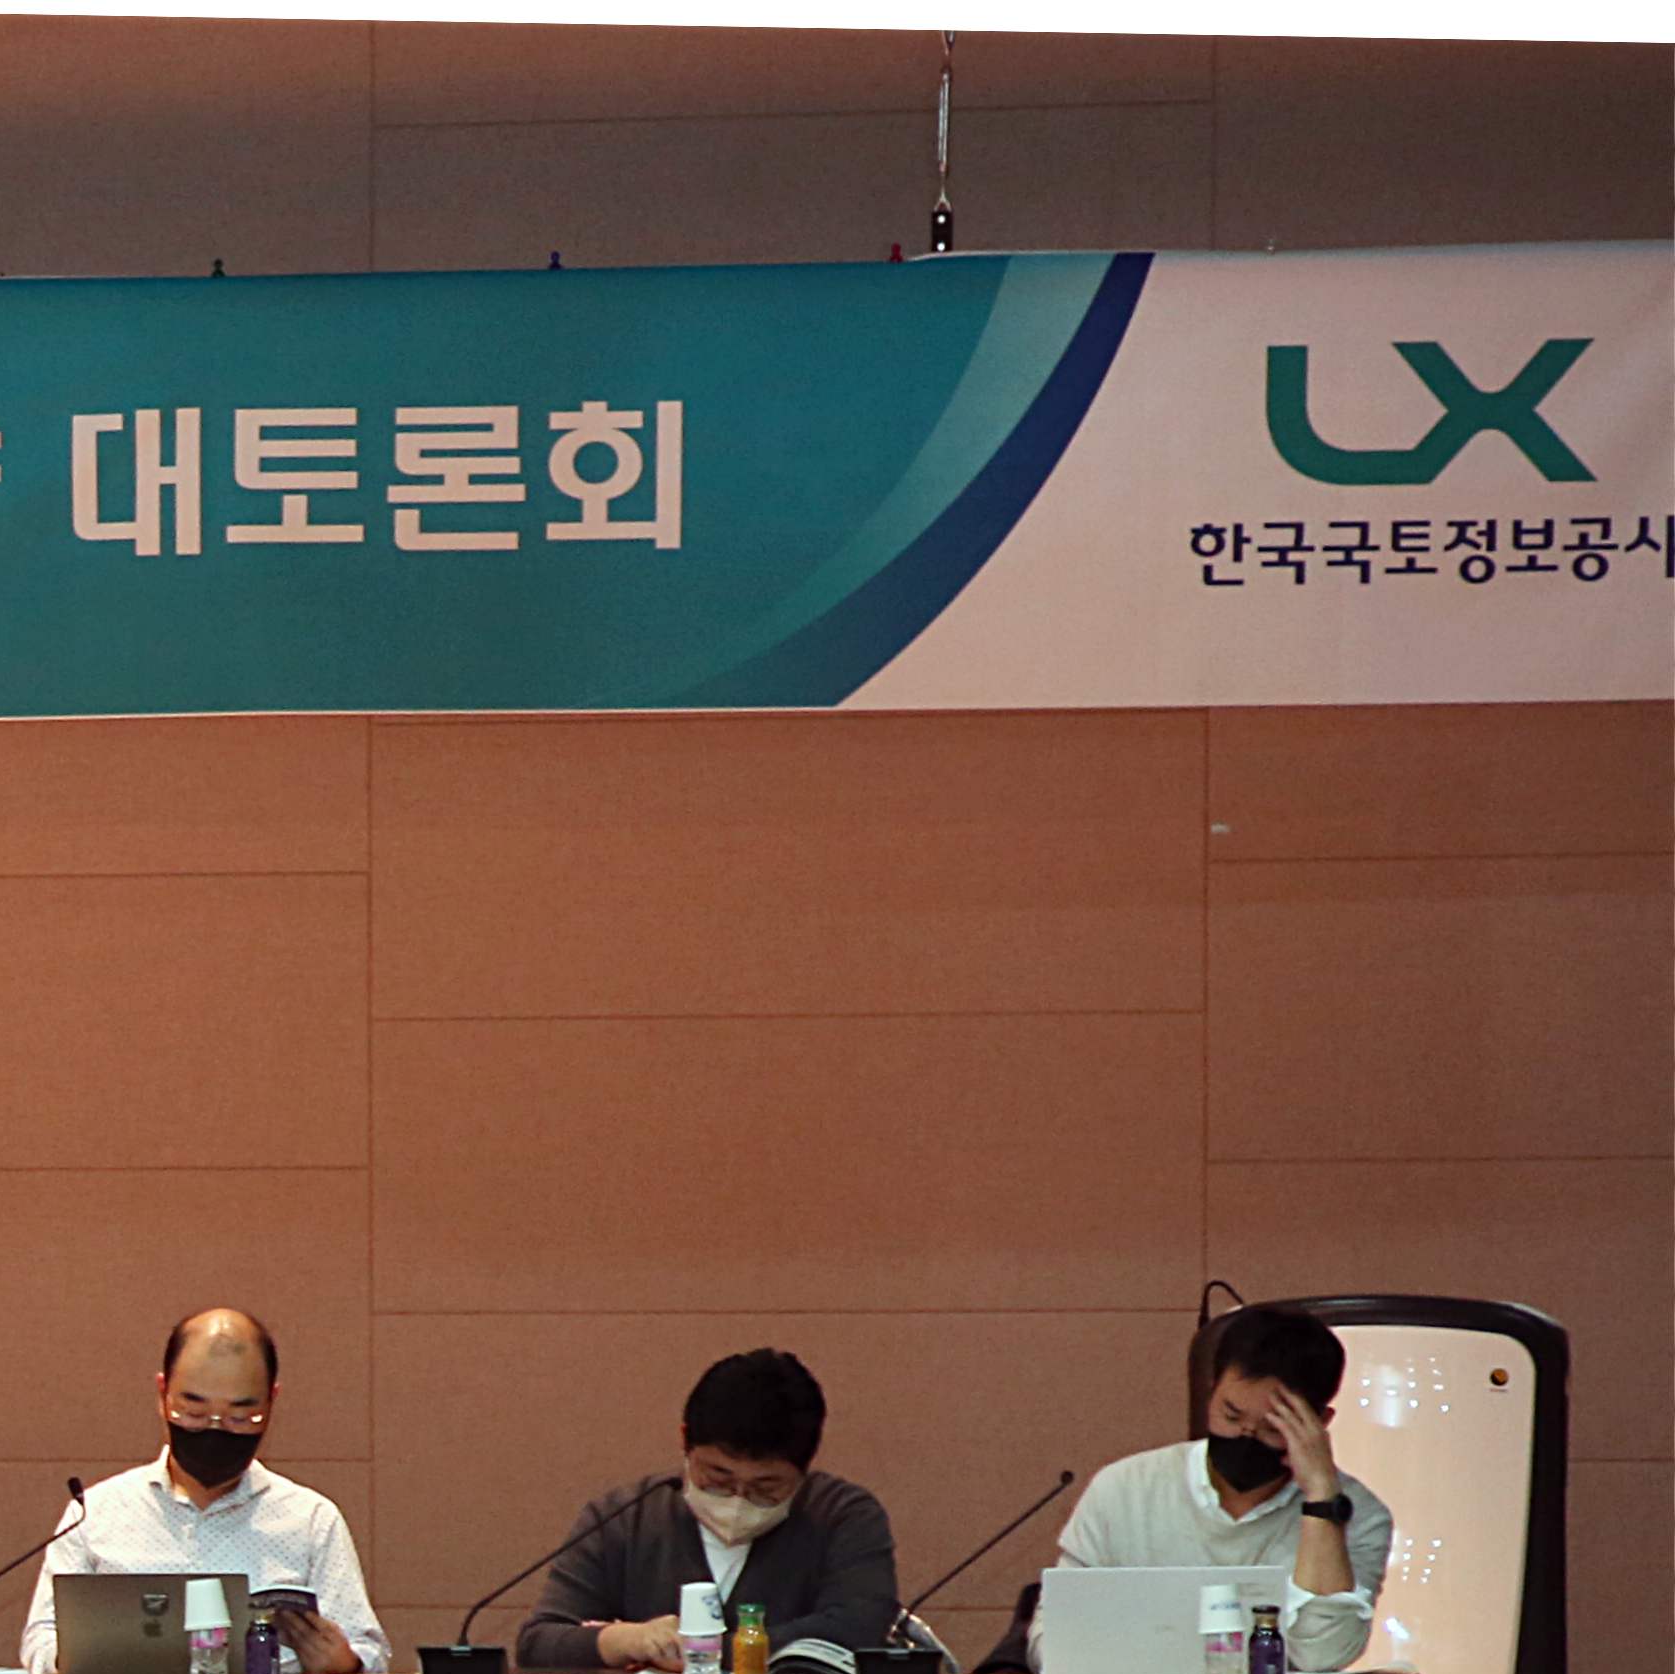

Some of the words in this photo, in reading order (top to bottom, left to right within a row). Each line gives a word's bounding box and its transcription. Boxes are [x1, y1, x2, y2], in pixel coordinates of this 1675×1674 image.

[71, 400, 683, 558] 대토론회
[1265, 337, 1598, 486] LX
[1190, 514, 1675, 587] 한국국토정보공사
